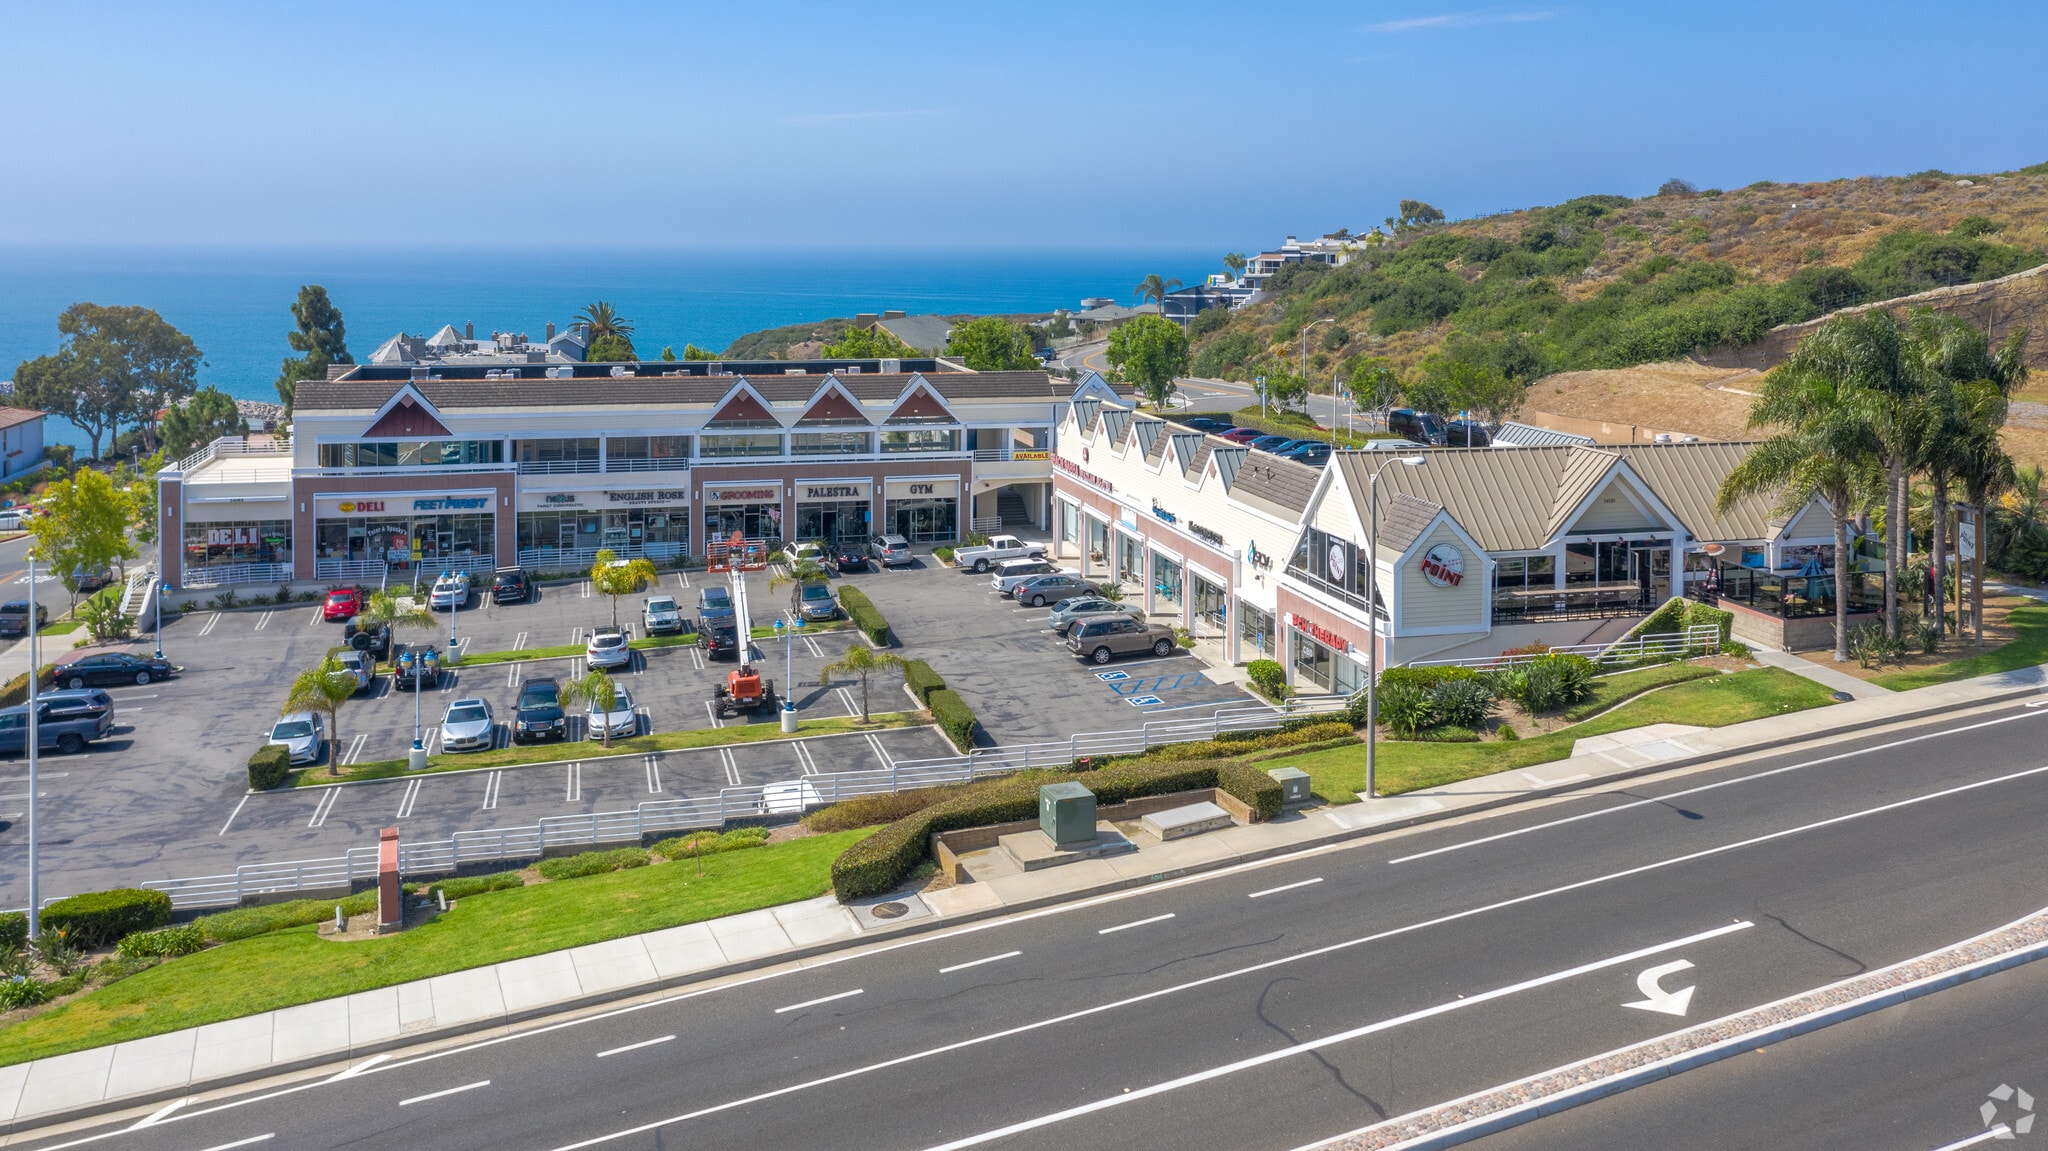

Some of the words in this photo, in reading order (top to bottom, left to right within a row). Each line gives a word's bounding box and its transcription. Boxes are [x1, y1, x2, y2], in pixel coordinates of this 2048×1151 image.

[1015, 452, 1049, 460] AVAILABLE
[807, 487, 859, 498] PALESTRA
[910, 484, 933, 494] GYM
[609, 492, 654, 501] ENGLISH
[657, 491, 685, 500] ROSE
[720, 490, 775, 500] GROOMING
[357, 501, 385, 512] DELI
[413, 499, 445, 510] FEET
[445, 498, 489, 509] FIRST
[207, 528, 258, 546] DELI
[1309, 622, 1348, 655] THERAPY
